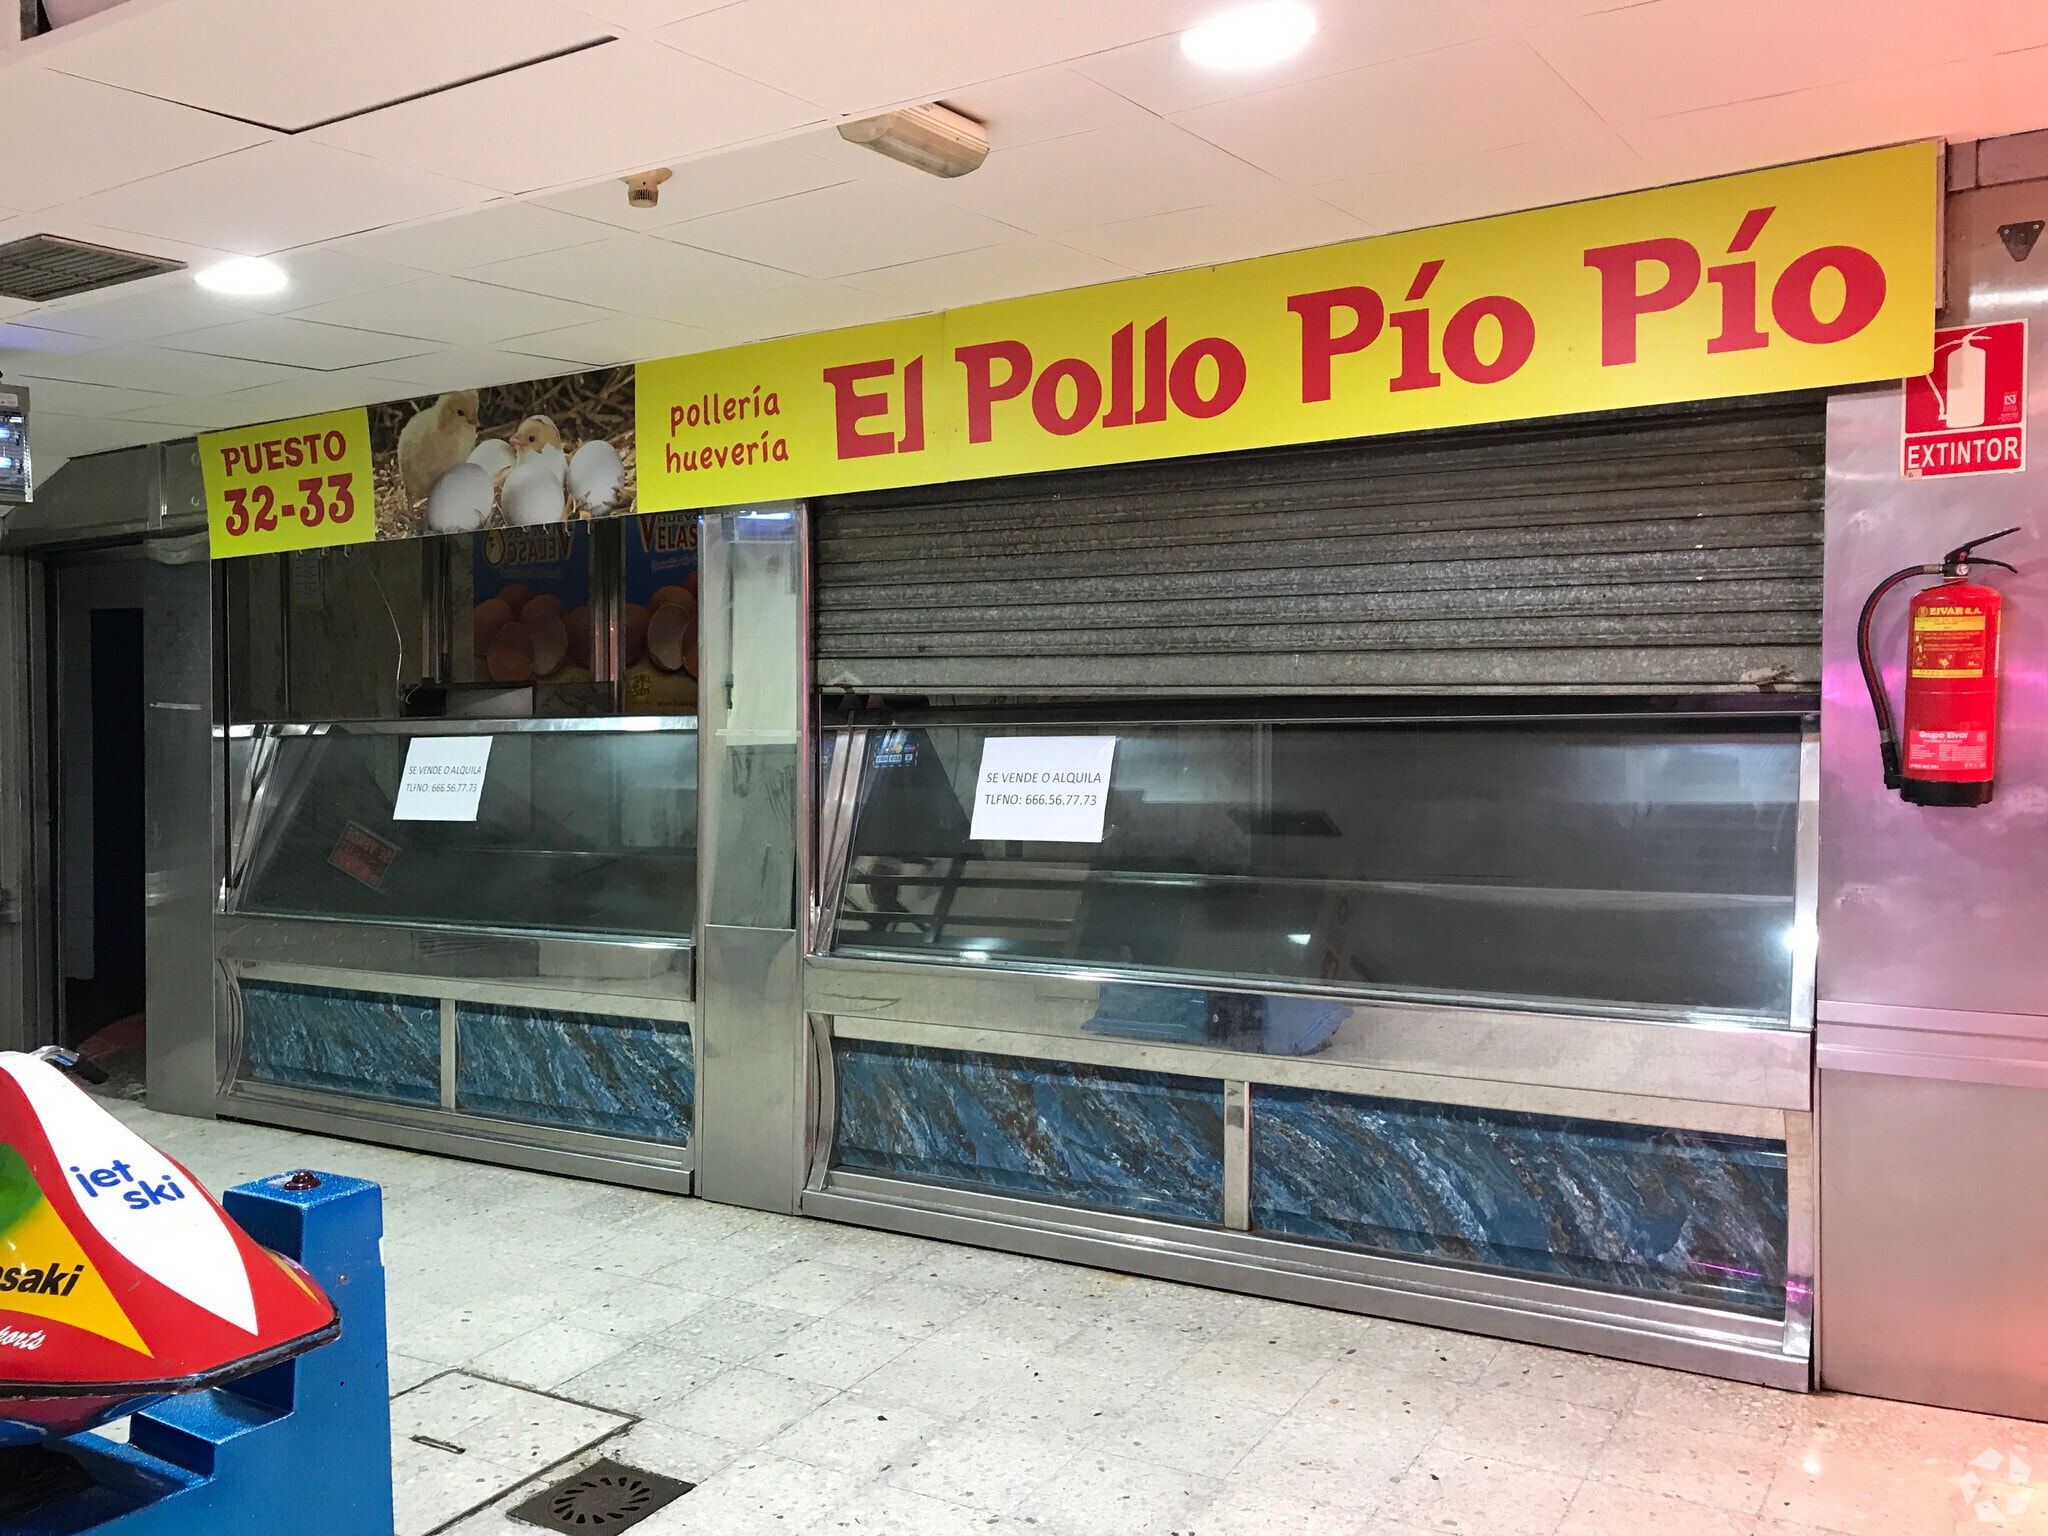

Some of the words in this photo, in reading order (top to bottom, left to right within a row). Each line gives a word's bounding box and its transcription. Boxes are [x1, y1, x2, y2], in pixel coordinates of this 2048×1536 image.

[823, 354, 925, 460] El
[955, 315, 1247, 444] Pollo
[1286, 259, 1536, 403] Pío
[1583, 206, 1887, 367] Pío
[670, 385, 780, 438] pollería
[220, 430, 346, 477] PUESTO
[666, 430, 789, 474] huevería
[1907, 436, 2019, 469] EXTINTOR
[223, 472, 355, 537] 32-33
[406, 783, 430, 793] TLFNO:
[432, 783, 478, 793] 666.56.77.73
[408, 766, 417, 775] SE
[419, 765, 442, 775] VENDE
[444, 766, 450, 775] O
[451, 766, 481, 775] ALQUILA
[986, 772, 999, 784] SE
[1002, 772, 1038, 784] VENDE
[1042, 772, 1051, 784] O
[1053, 772, 1102, 785] ALQUILA
[985, 794, 1022, 806] TLFNO:
[1026, 794, 1097, 807] 666.56.77.73
[70, 1160, 134, 1198] jet
[123, 1175, 185, 1210] ski
